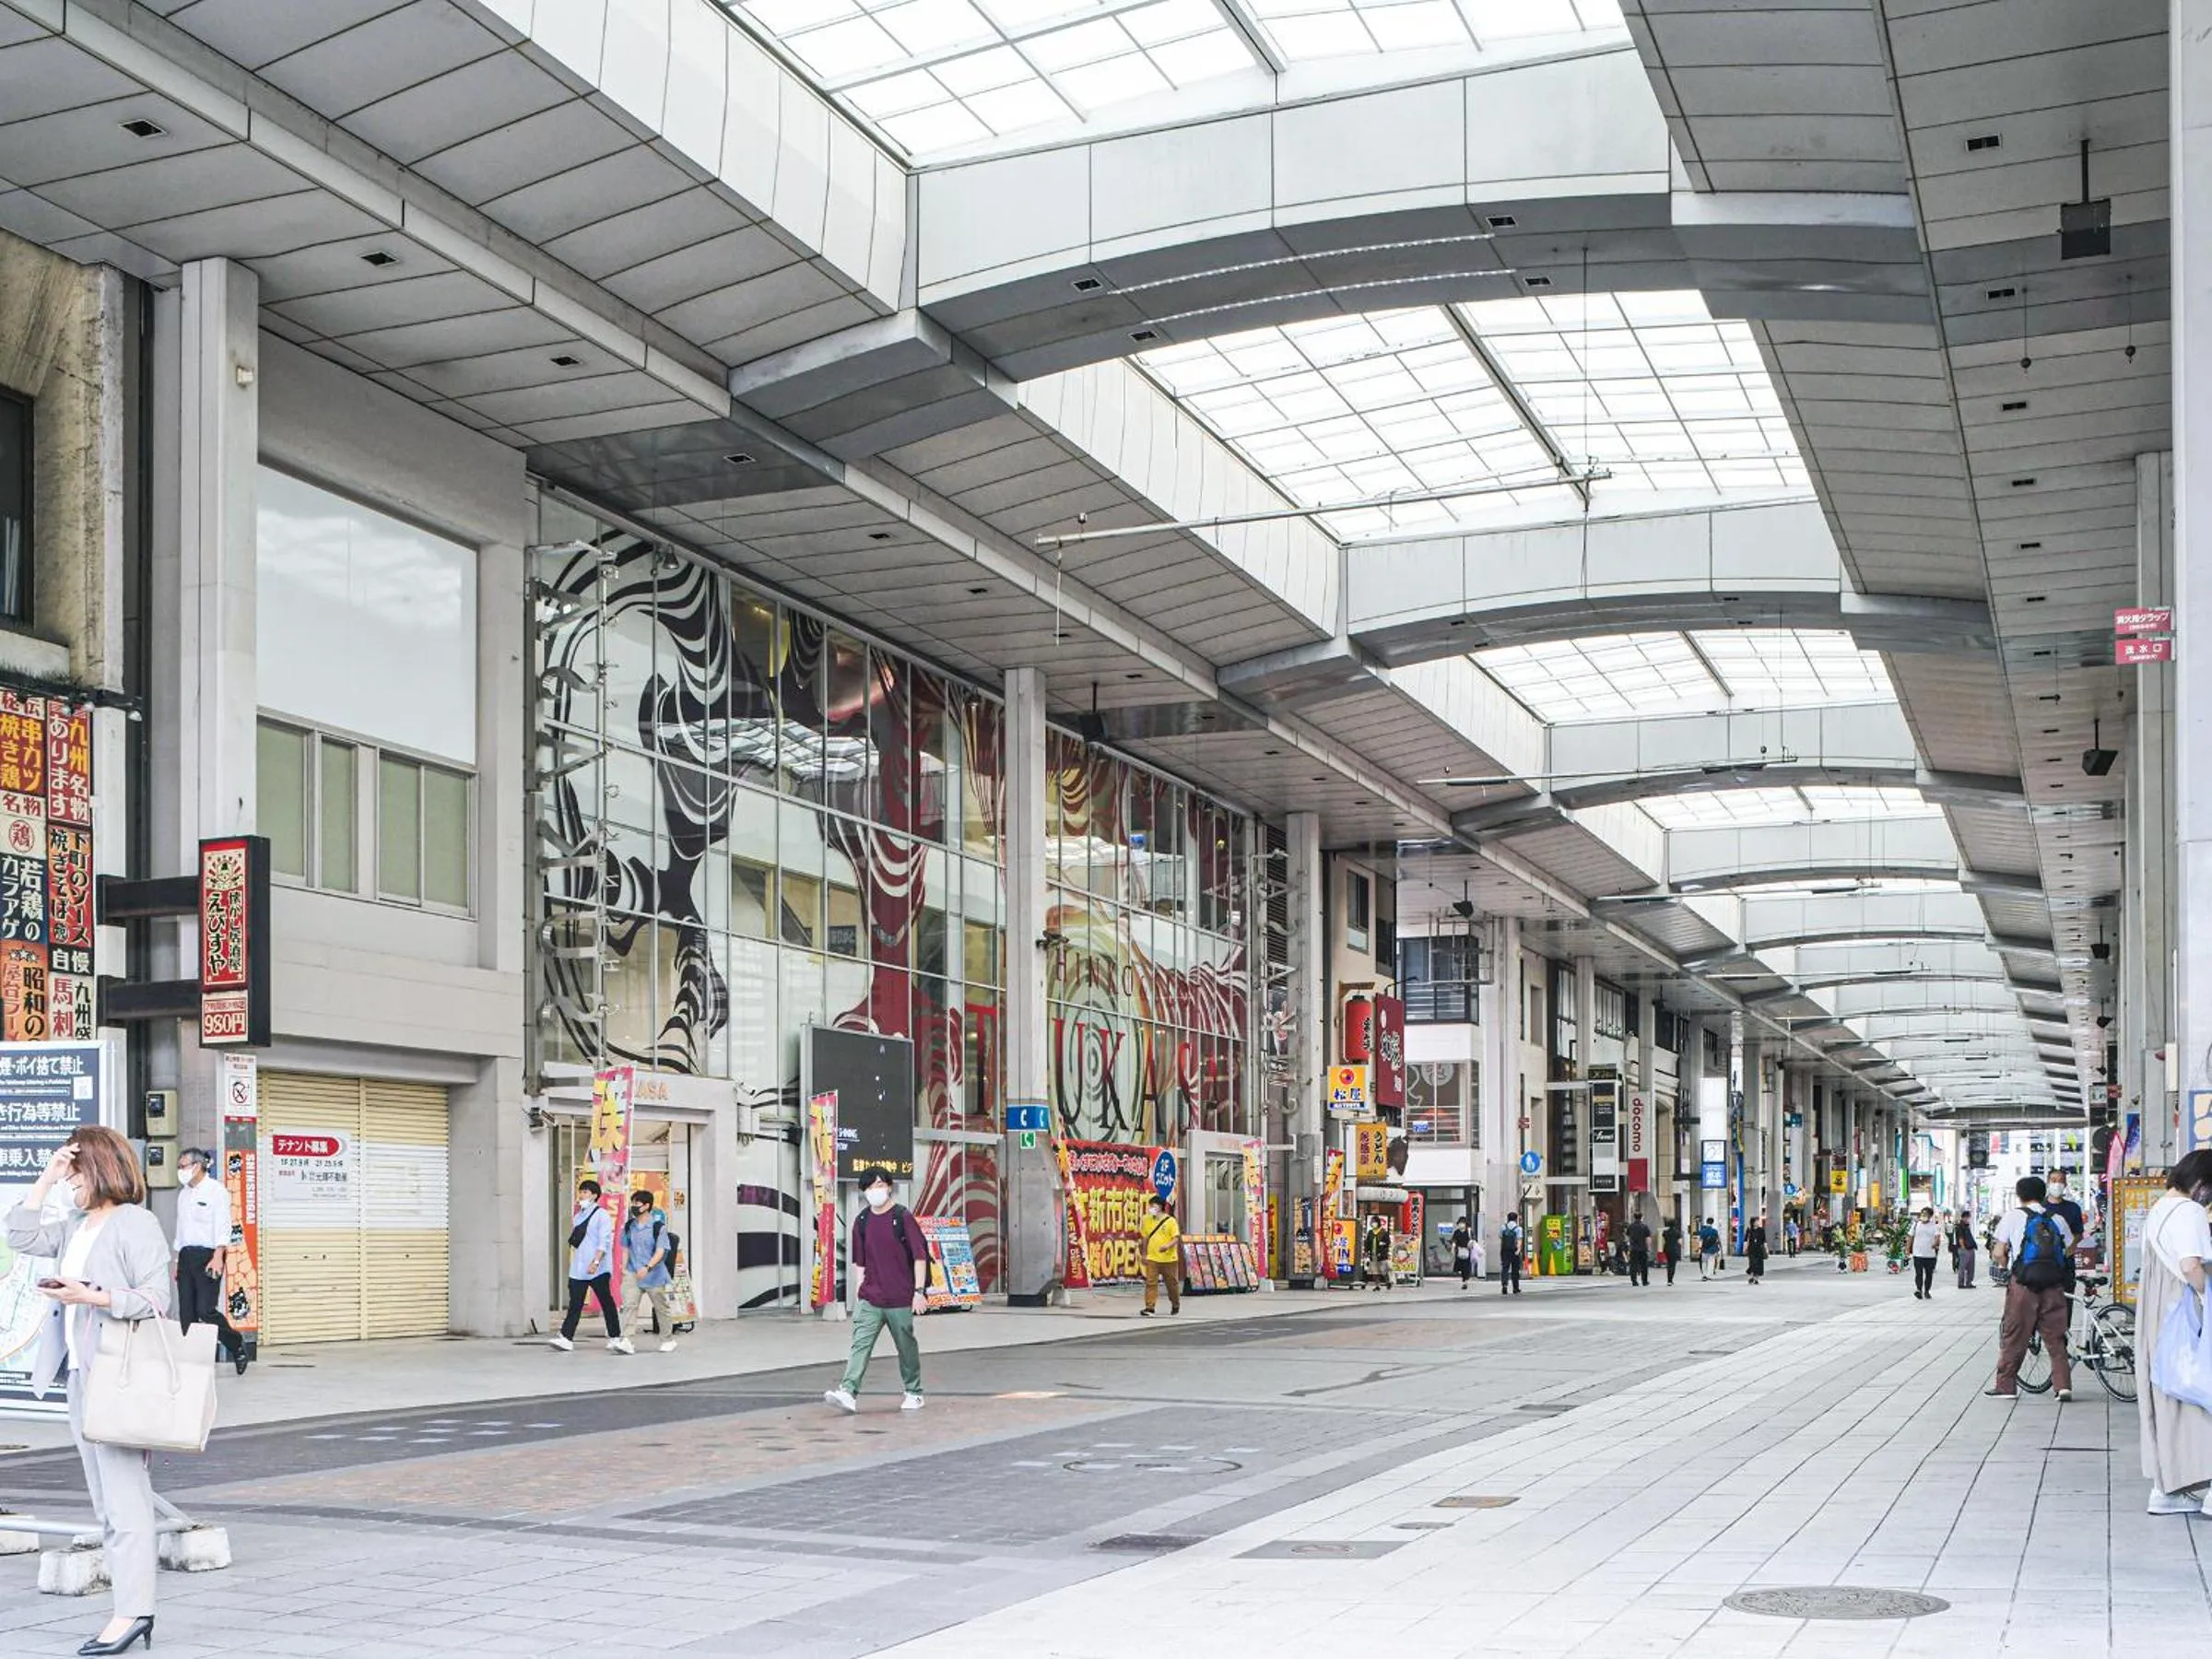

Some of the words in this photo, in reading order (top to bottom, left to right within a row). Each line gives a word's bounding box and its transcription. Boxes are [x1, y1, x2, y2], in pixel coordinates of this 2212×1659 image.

[22, 719, 42, 792] 串カツ
[50, 714, 69, 818] あります
[69, 716, 89, 823] 九州名物
[3, 793, 41, 817] 名物
[2, 855, 19, 938] カラアゲ
[20, 859, 43, 940] 若鶏の
[68, 833, 90, 945] 下町のソース
[53, 948, 90, 974] 自慢
[207, 892, 227, 975] えびすや
[23, 967, 45, 1040] 昭和の
[53, 977, 73, 1037] 馬刺
[205, 1014, 246, 1034] 980円
[1632, 1098, 1642, 1152] docomo
